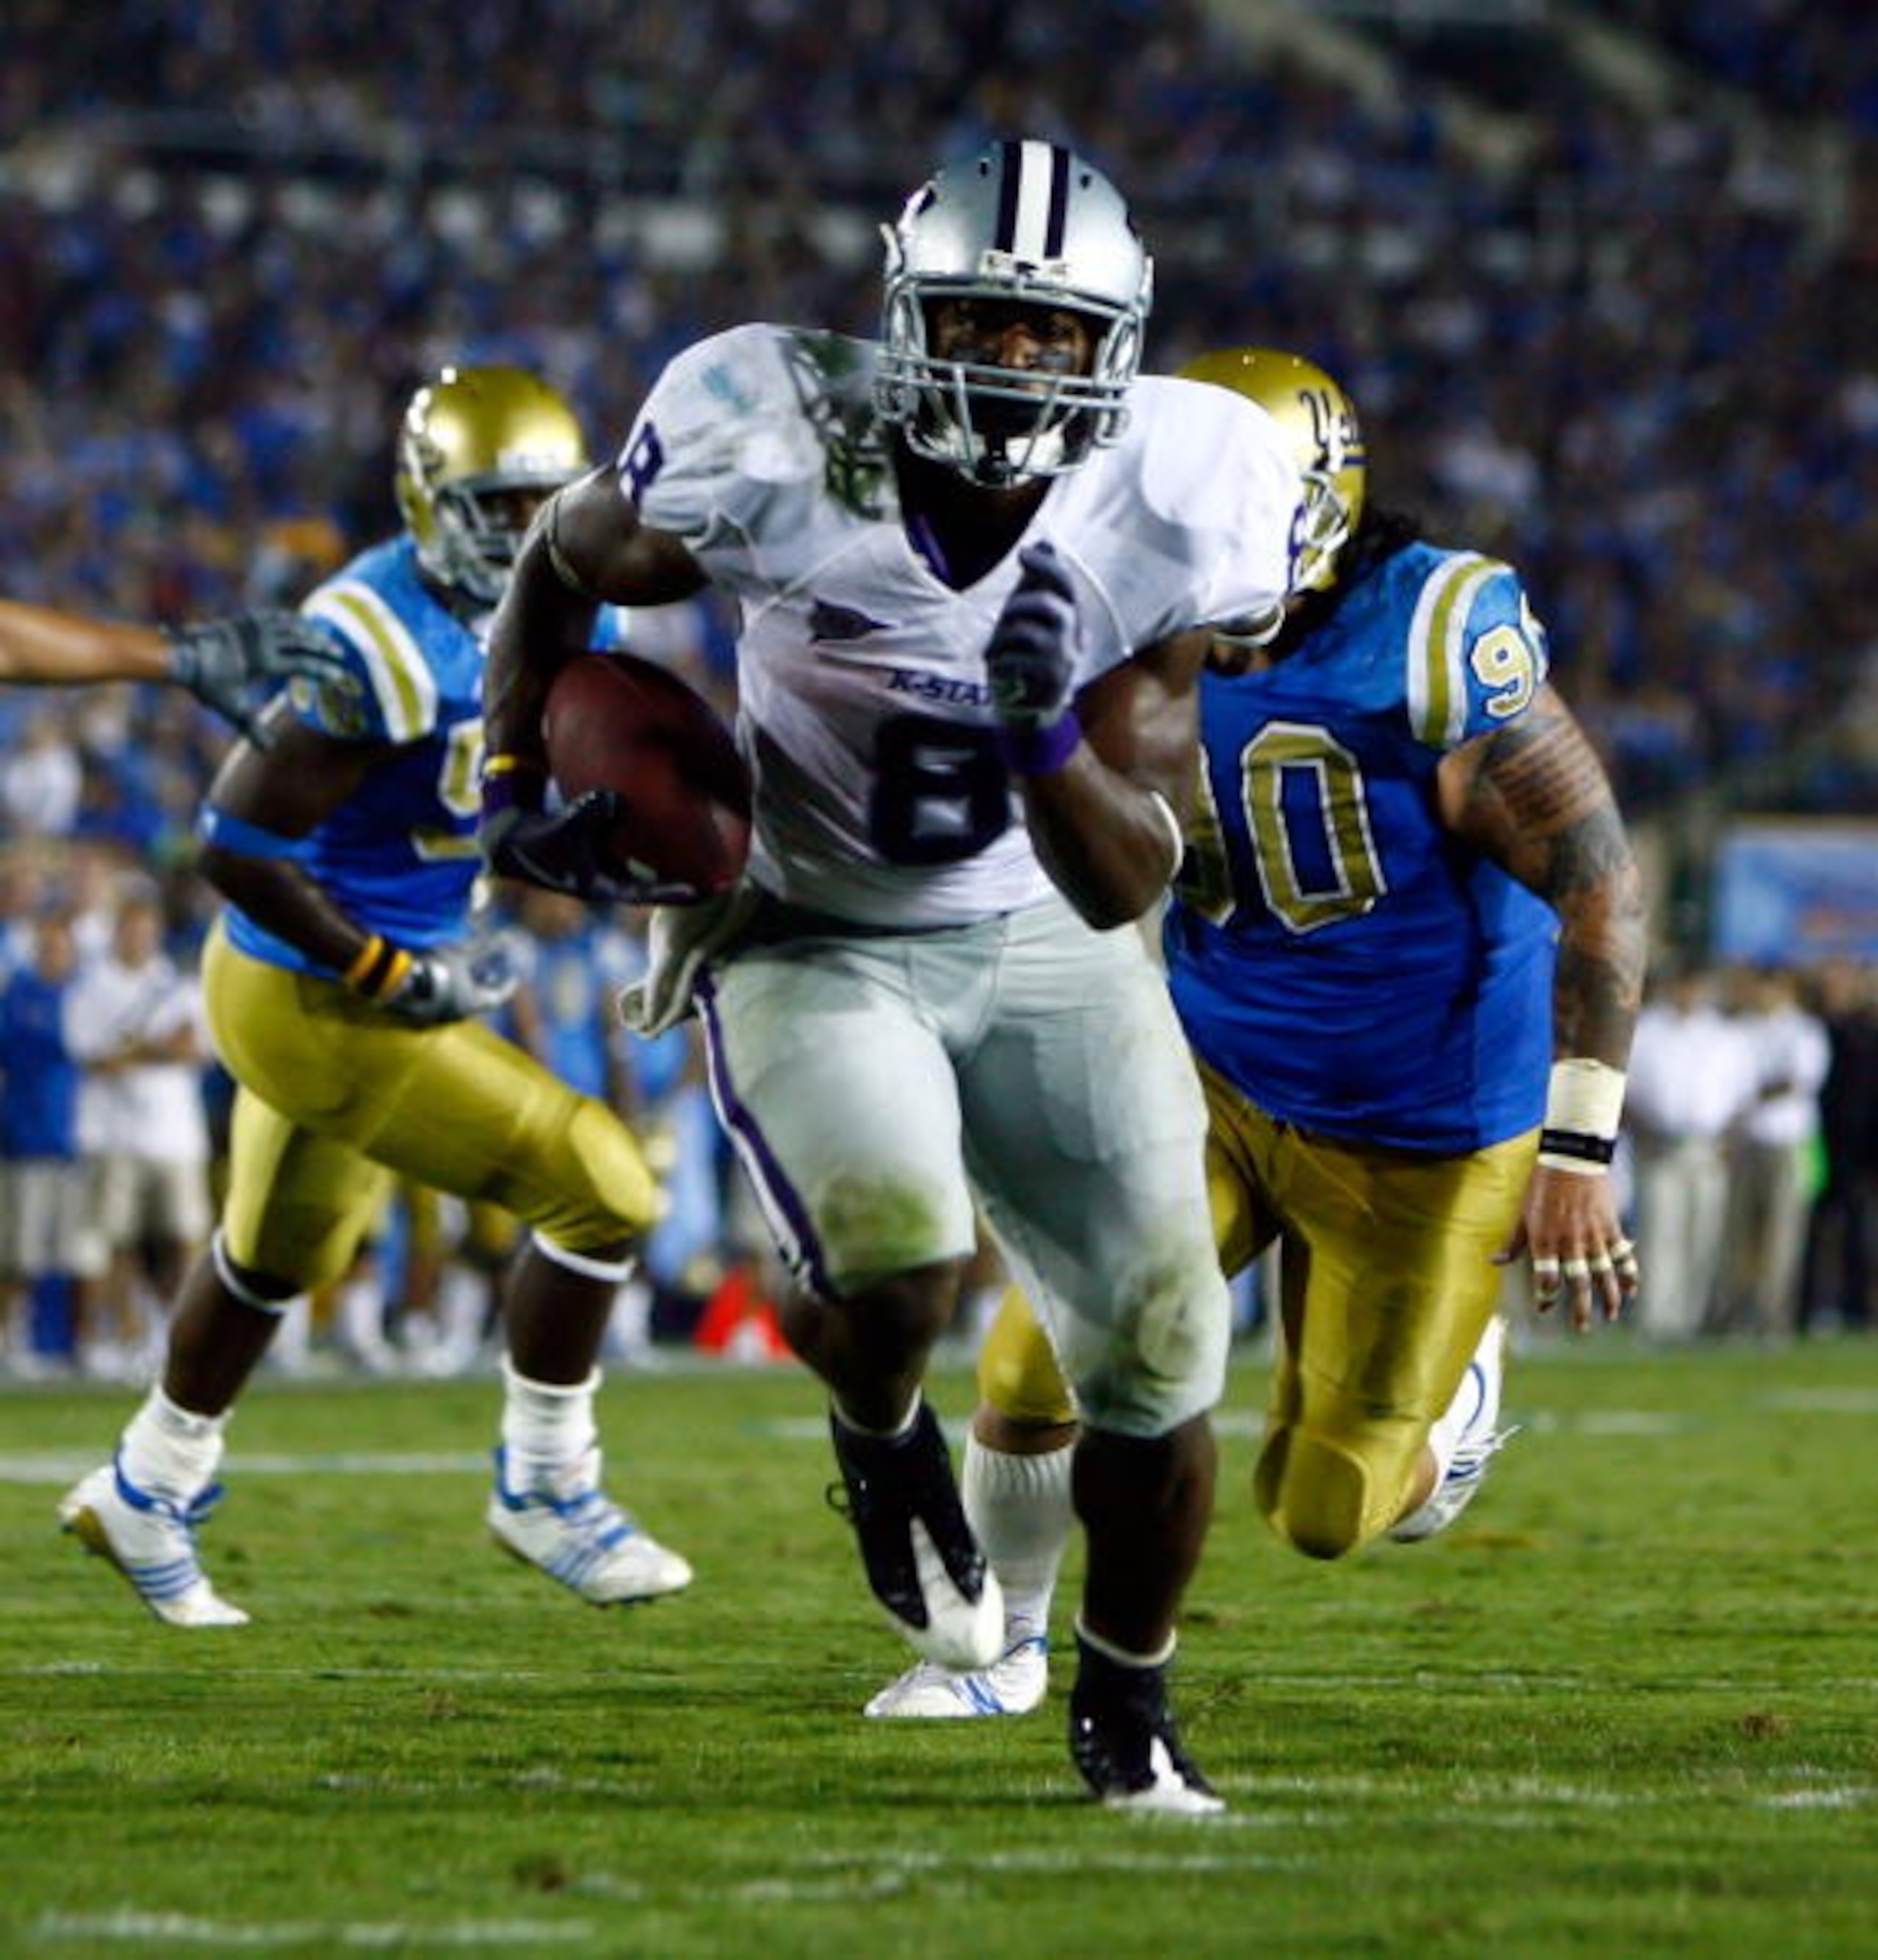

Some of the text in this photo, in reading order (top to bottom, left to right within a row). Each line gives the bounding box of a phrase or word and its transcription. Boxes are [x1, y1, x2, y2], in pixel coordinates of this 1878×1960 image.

[886, 669, 993, 707] K-STA
[1469, 589, 1549, 719] 9
[869, 714, 1011, 867] 8
[1183, 720, 1387, 934] 0
